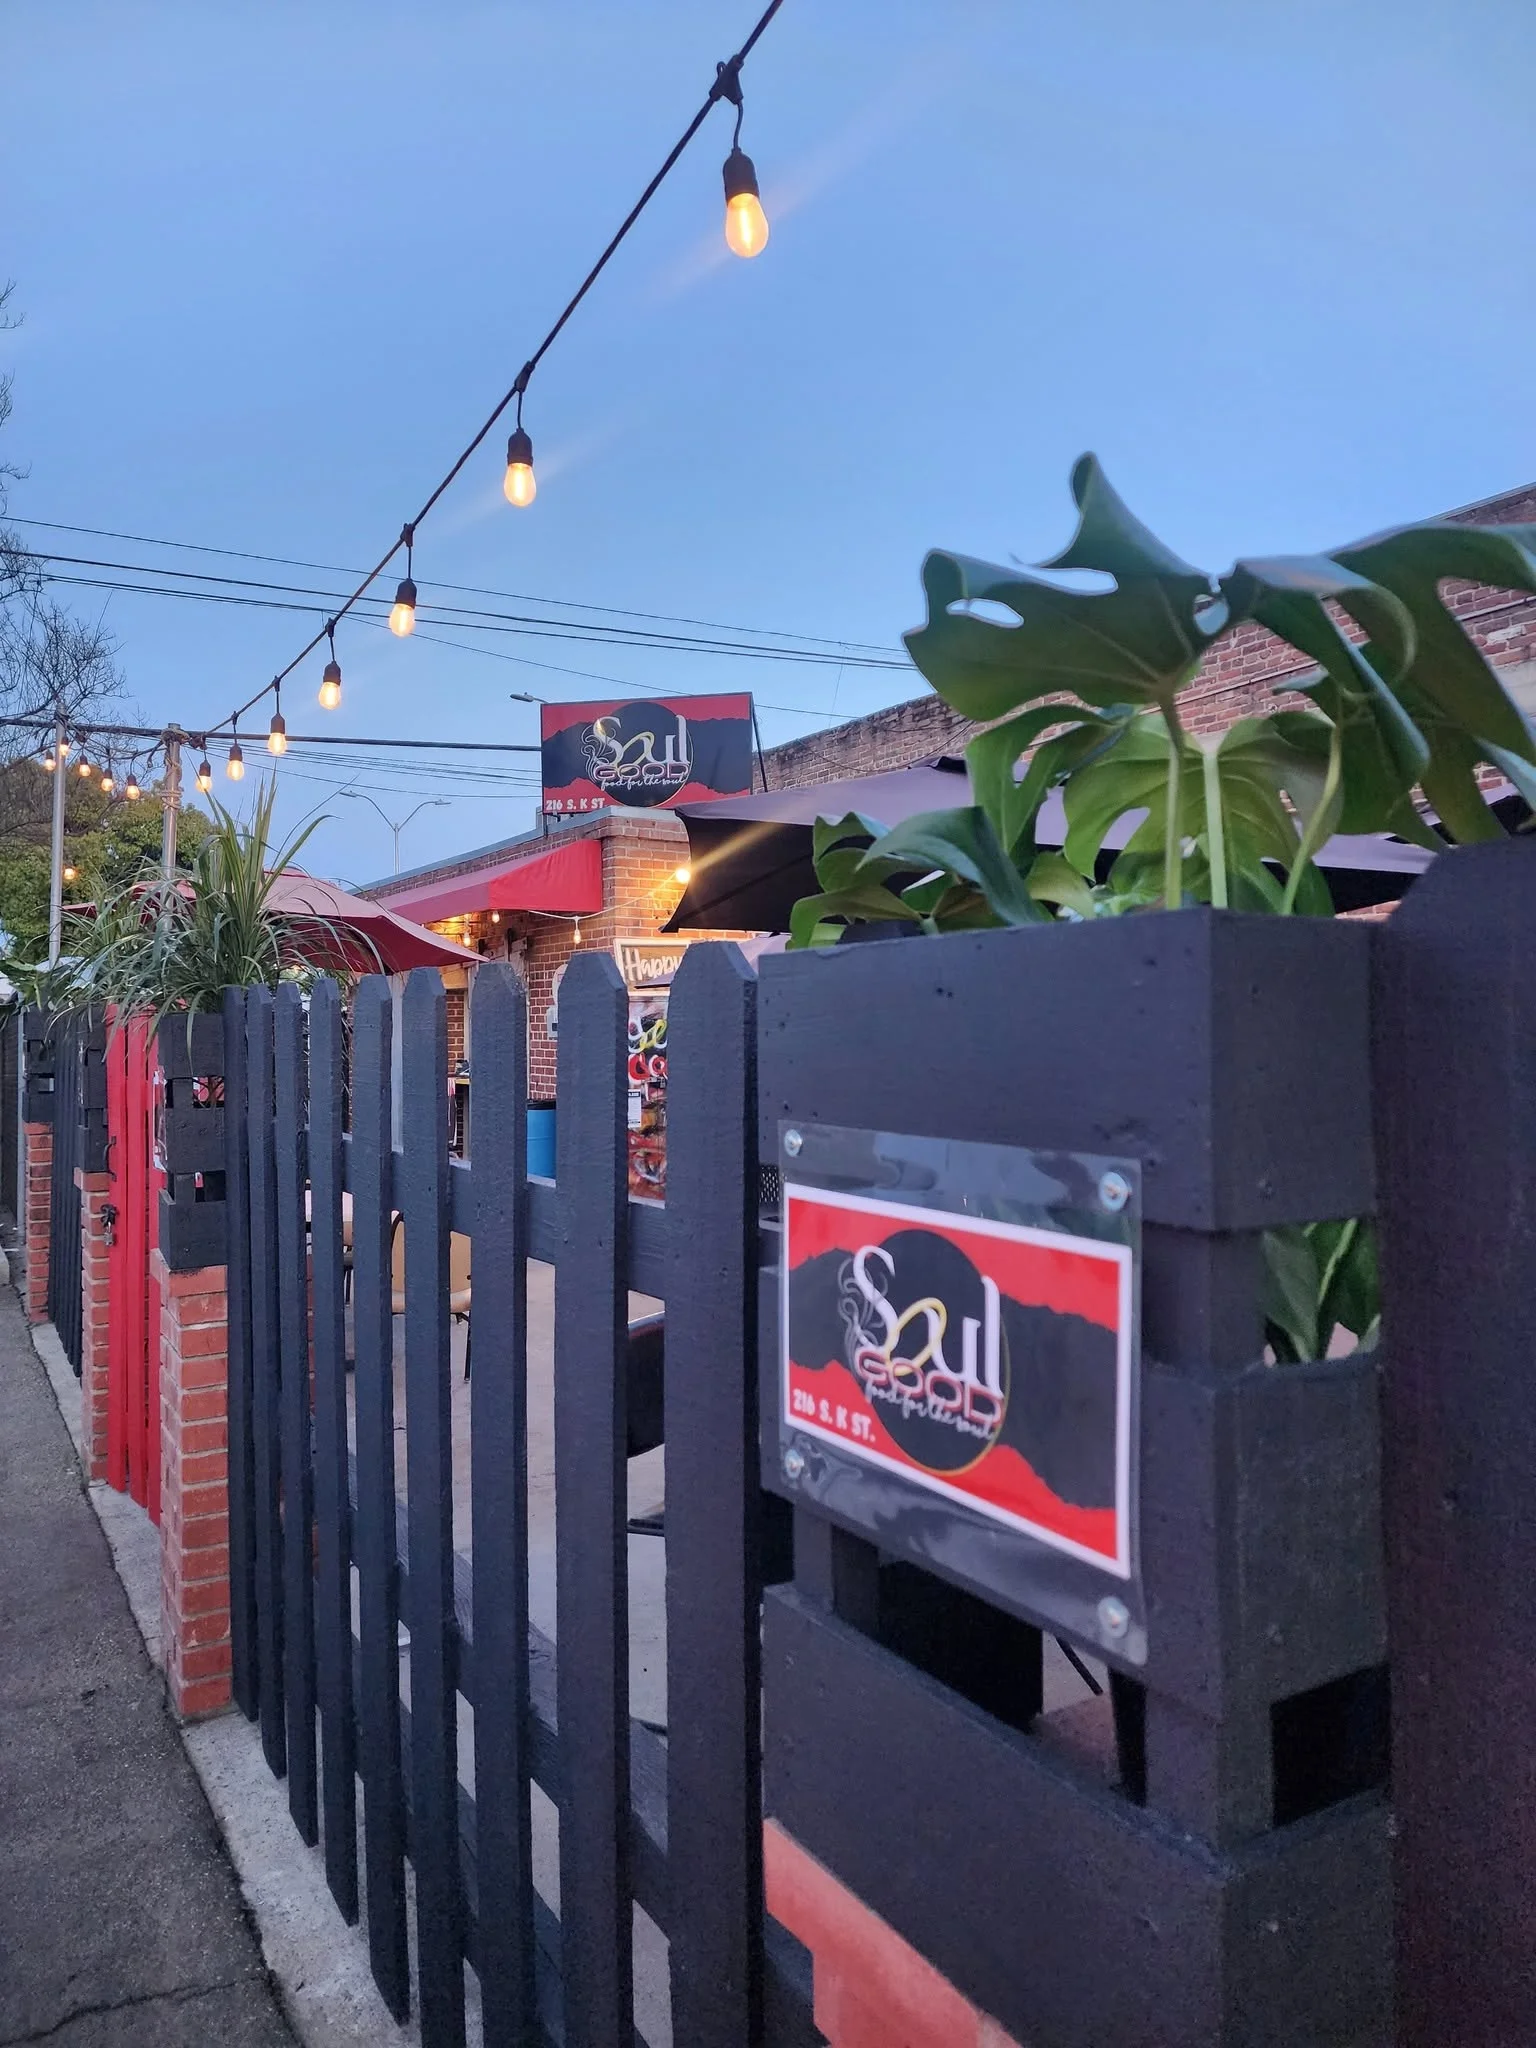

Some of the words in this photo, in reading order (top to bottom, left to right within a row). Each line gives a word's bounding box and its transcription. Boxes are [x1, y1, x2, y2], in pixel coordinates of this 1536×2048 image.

[593, 714, 690, 772] Soul
[593, 763, 688, 780] GOOD
[546, 799, 563, 811] 216
[567, 798, 577, 810] S.
[580, 797, 588, 810] K
[853, 1245, 1004, 1398] Soul
[854, 1347, 1004, 1427] GOOD
[819, 1397, 833, 1424] S.
[836, 1404, 848, 1430] K
[851, 1411, 876, 1442] ST.
